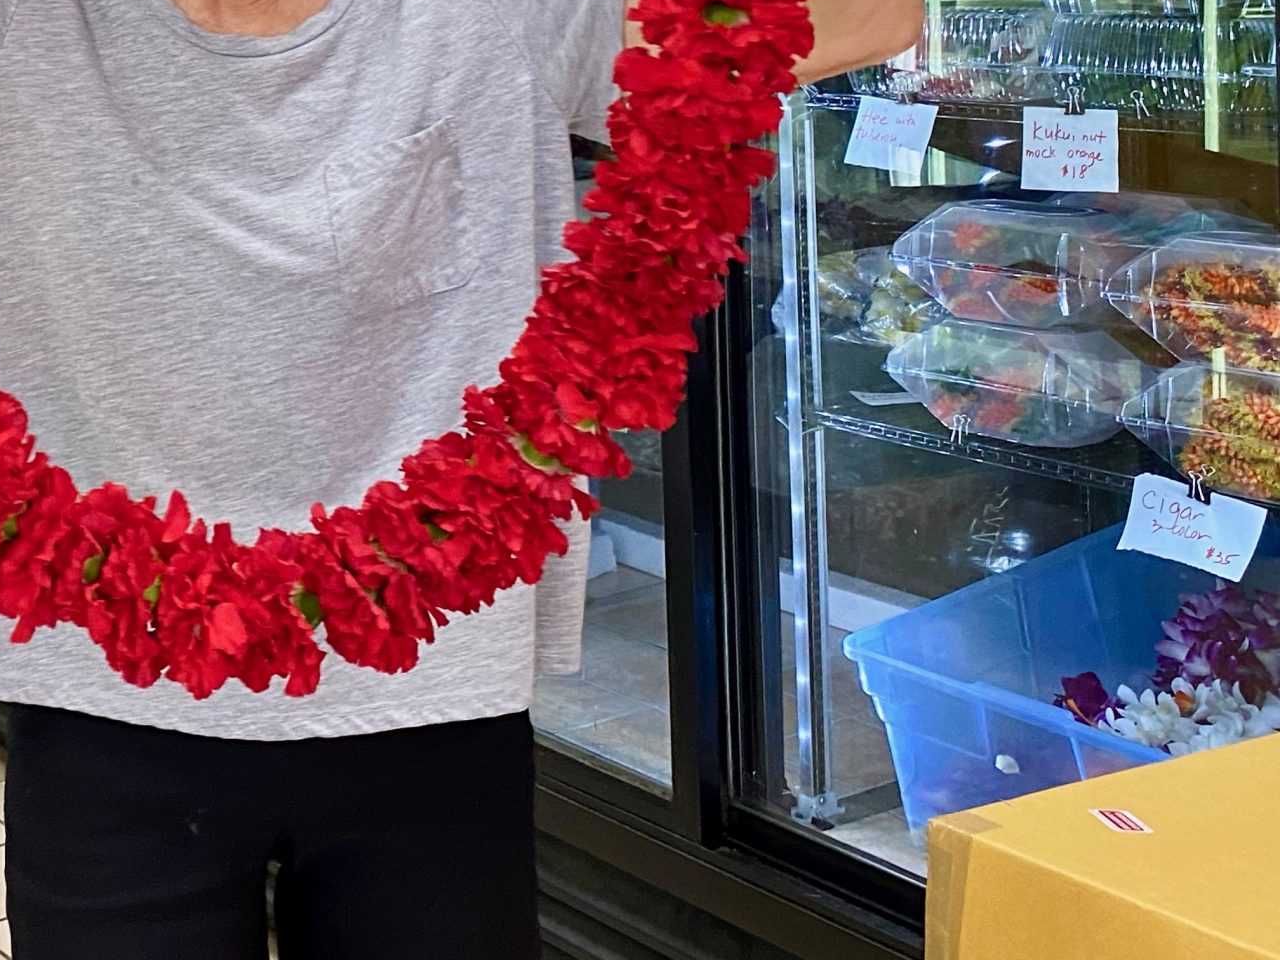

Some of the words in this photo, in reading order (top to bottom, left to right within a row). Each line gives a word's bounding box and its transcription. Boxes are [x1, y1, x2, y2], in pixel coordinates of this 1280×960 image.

[1032, 121, 1075, 142] Kukui
[1082, 131, 1106, 142] nut
[1025, 147, 1056, 158] mock
[1067, 149, 1104, 168] orange
[1060, 164, 1089, 180] $18
